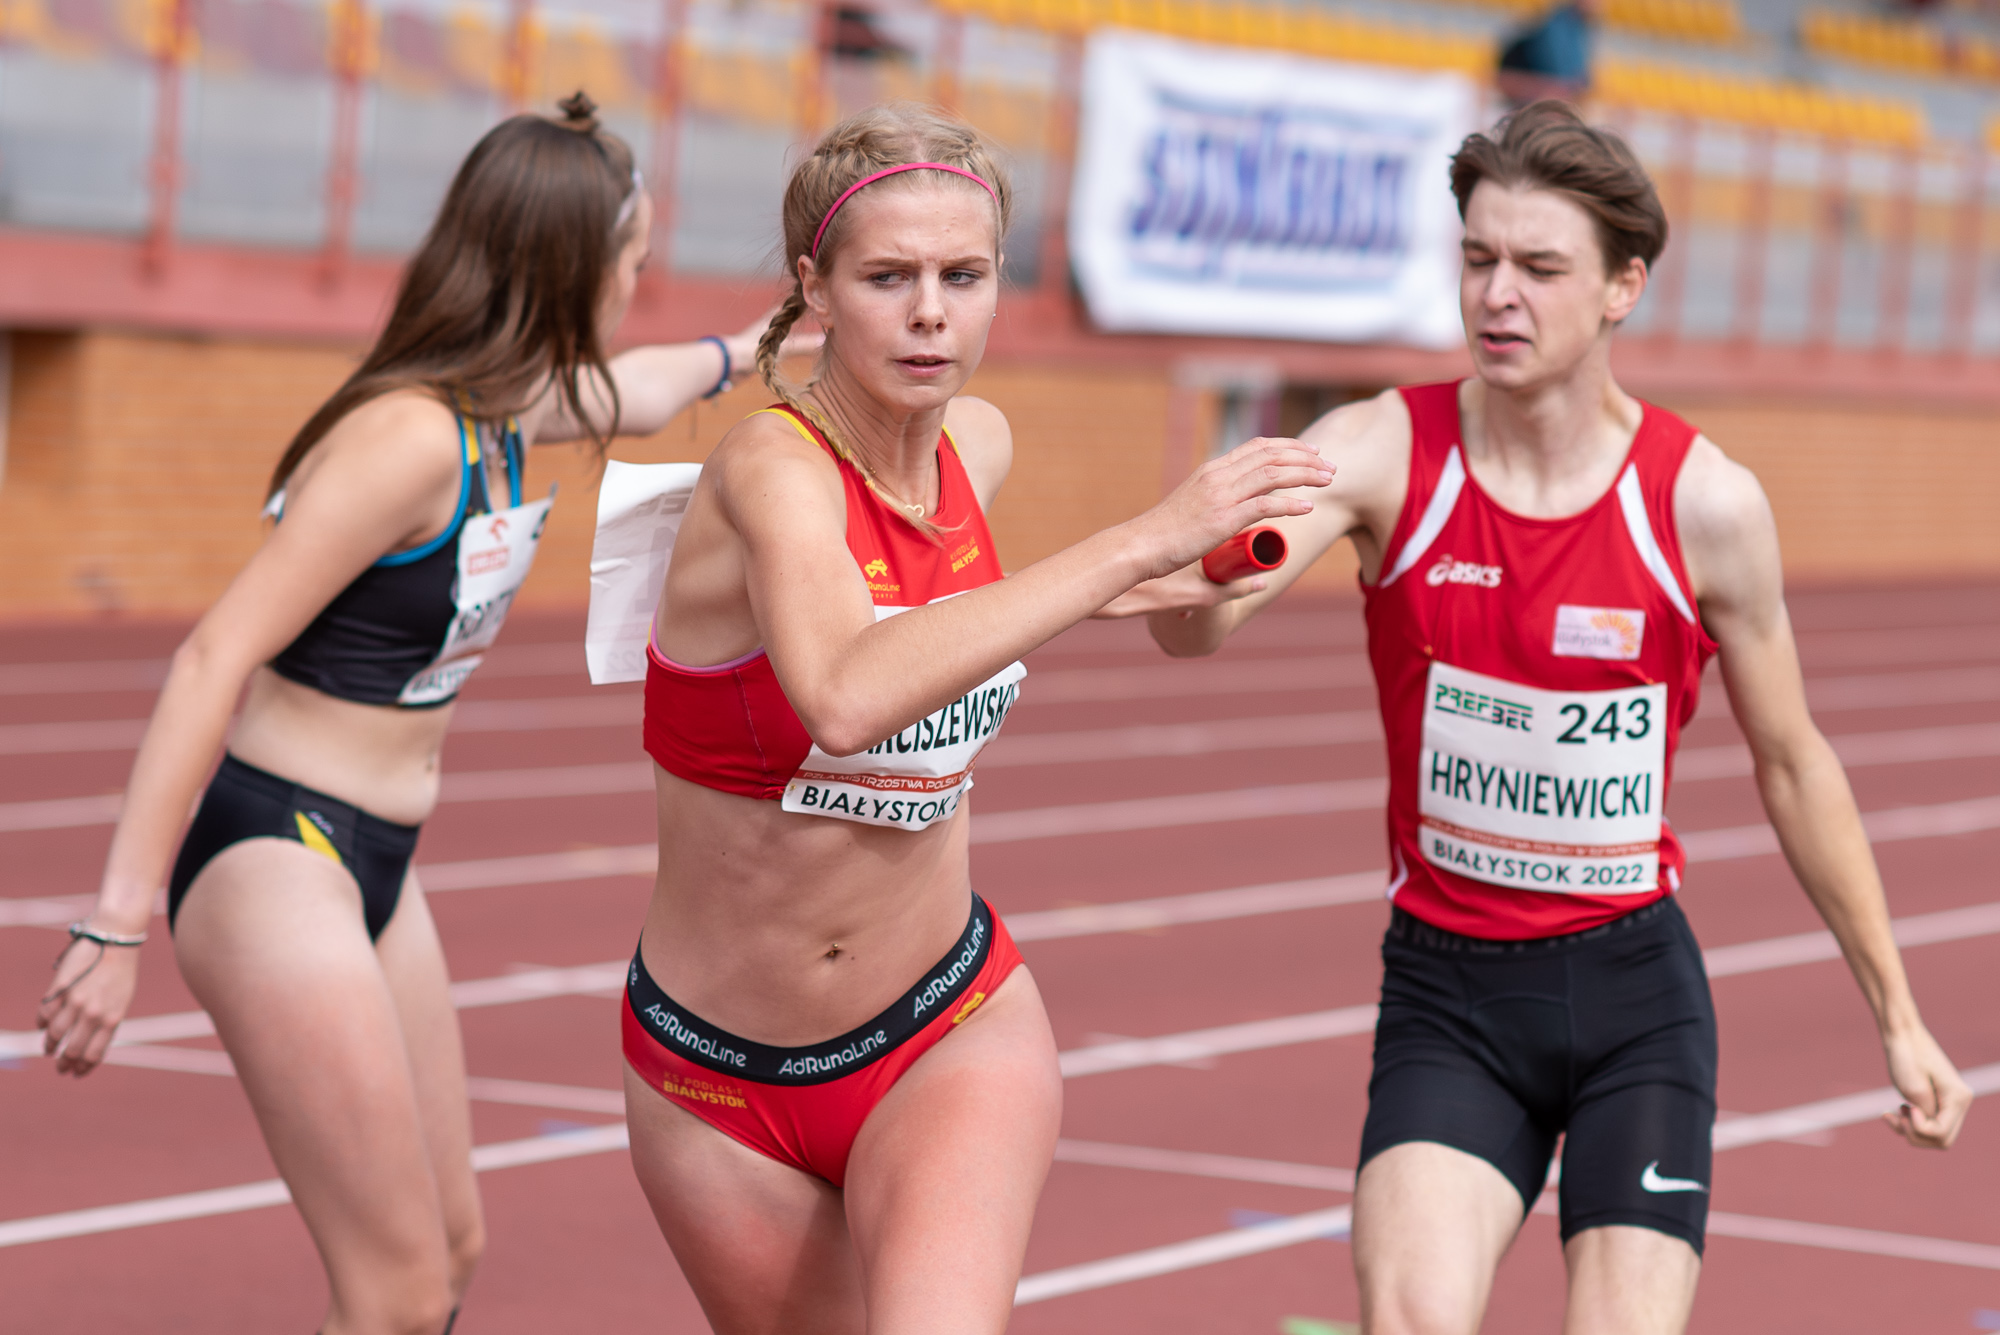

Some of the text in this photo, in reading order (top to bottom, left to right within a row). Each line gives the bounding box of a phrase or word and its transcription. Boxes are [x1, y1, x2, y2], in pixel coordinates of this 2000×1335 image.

[1434, 684, 1534, 733] PREFBET
[1556, 698, 1651, 744] 243
[801, 785, 951, 823] BIAŁYSTOK
[837, 775, 924, 790] MISTRZOSTWA
[925, 777, 958, 790] POLSKI
[1431, 751, 1651, 819] HRYNIEWICKI
[1434, 839, 1644, 885] BIAŁYSTOK 2022
[914, 917, 985, 1018] AdRunaLine
[644, 1003, 747, 1067] AdRunaLine
[778, 1029, 888, 1075] AdRunaLine
[663, 1080, 748, 1109] BIAŁYSTOK
